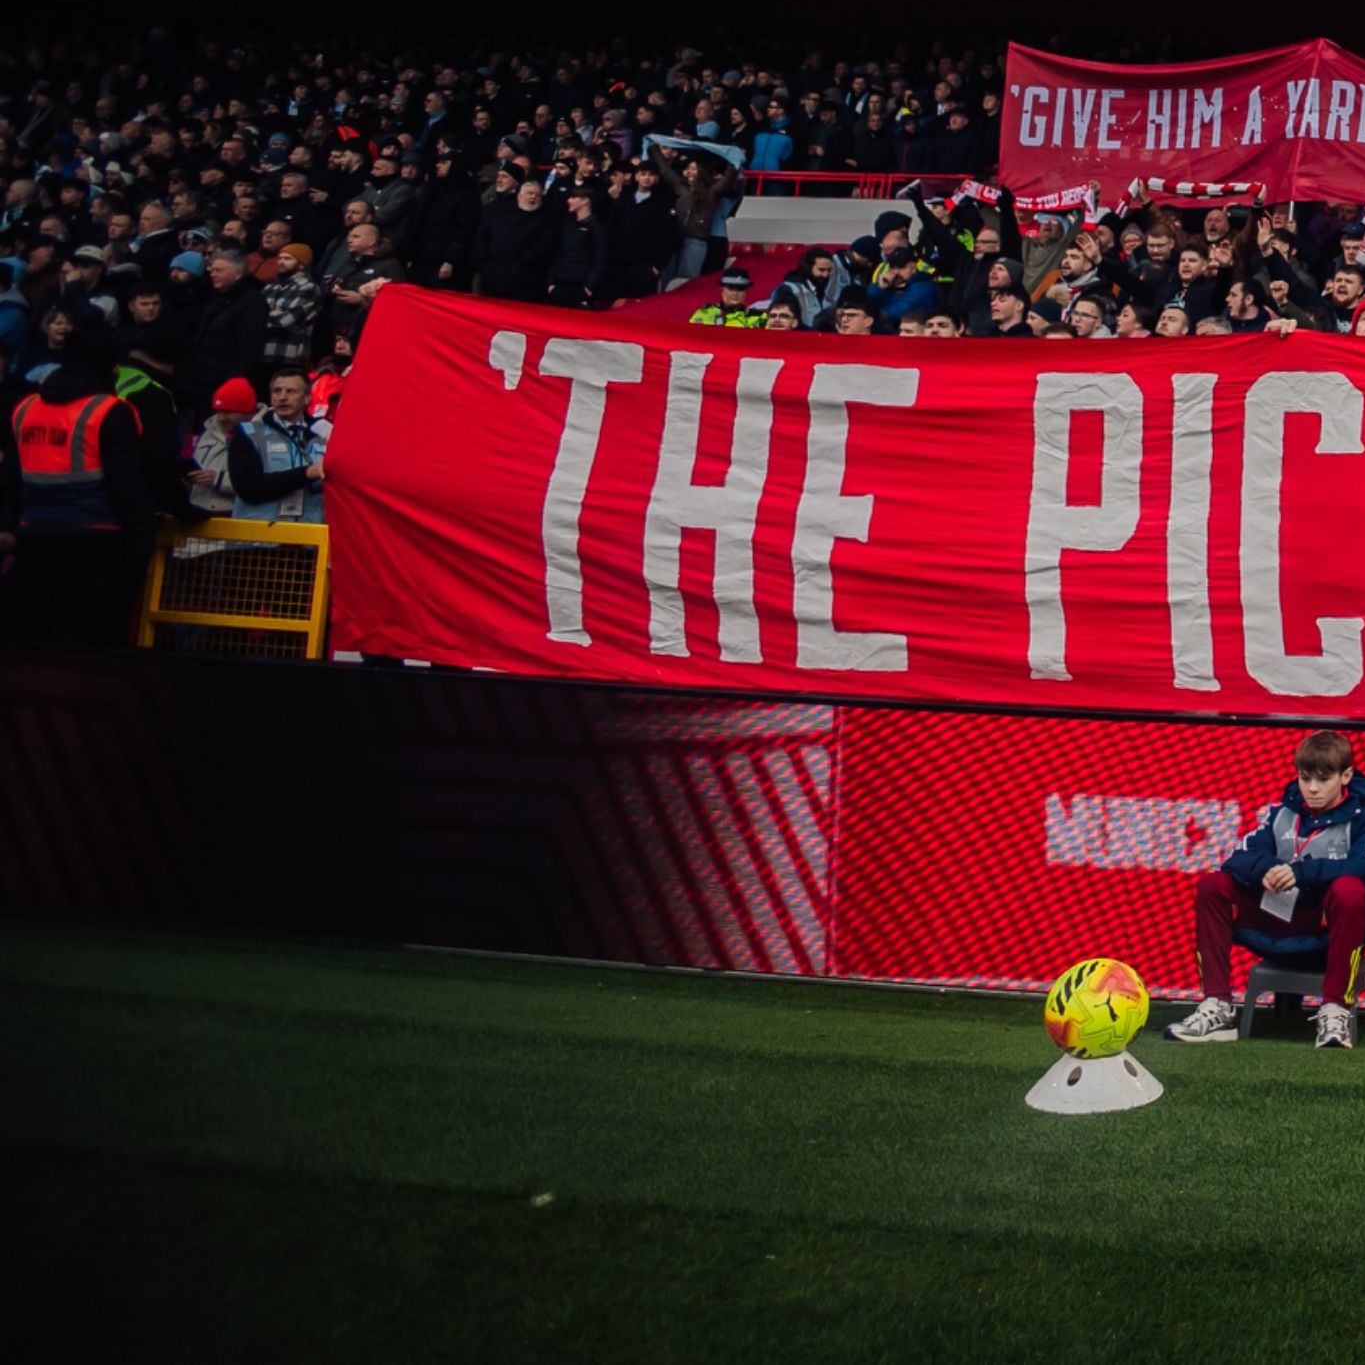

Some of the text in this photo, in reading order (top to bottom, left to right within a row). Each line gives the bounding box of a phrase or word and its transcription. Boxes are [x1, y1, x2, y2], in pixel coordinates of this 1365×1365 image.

[1010, 84, 1125, 148] 'GIVE
[1145, 88, 1224, 149] HIM
[1241, 85, 1264, 146] A
[490, 331, 919, 673] 'THE
